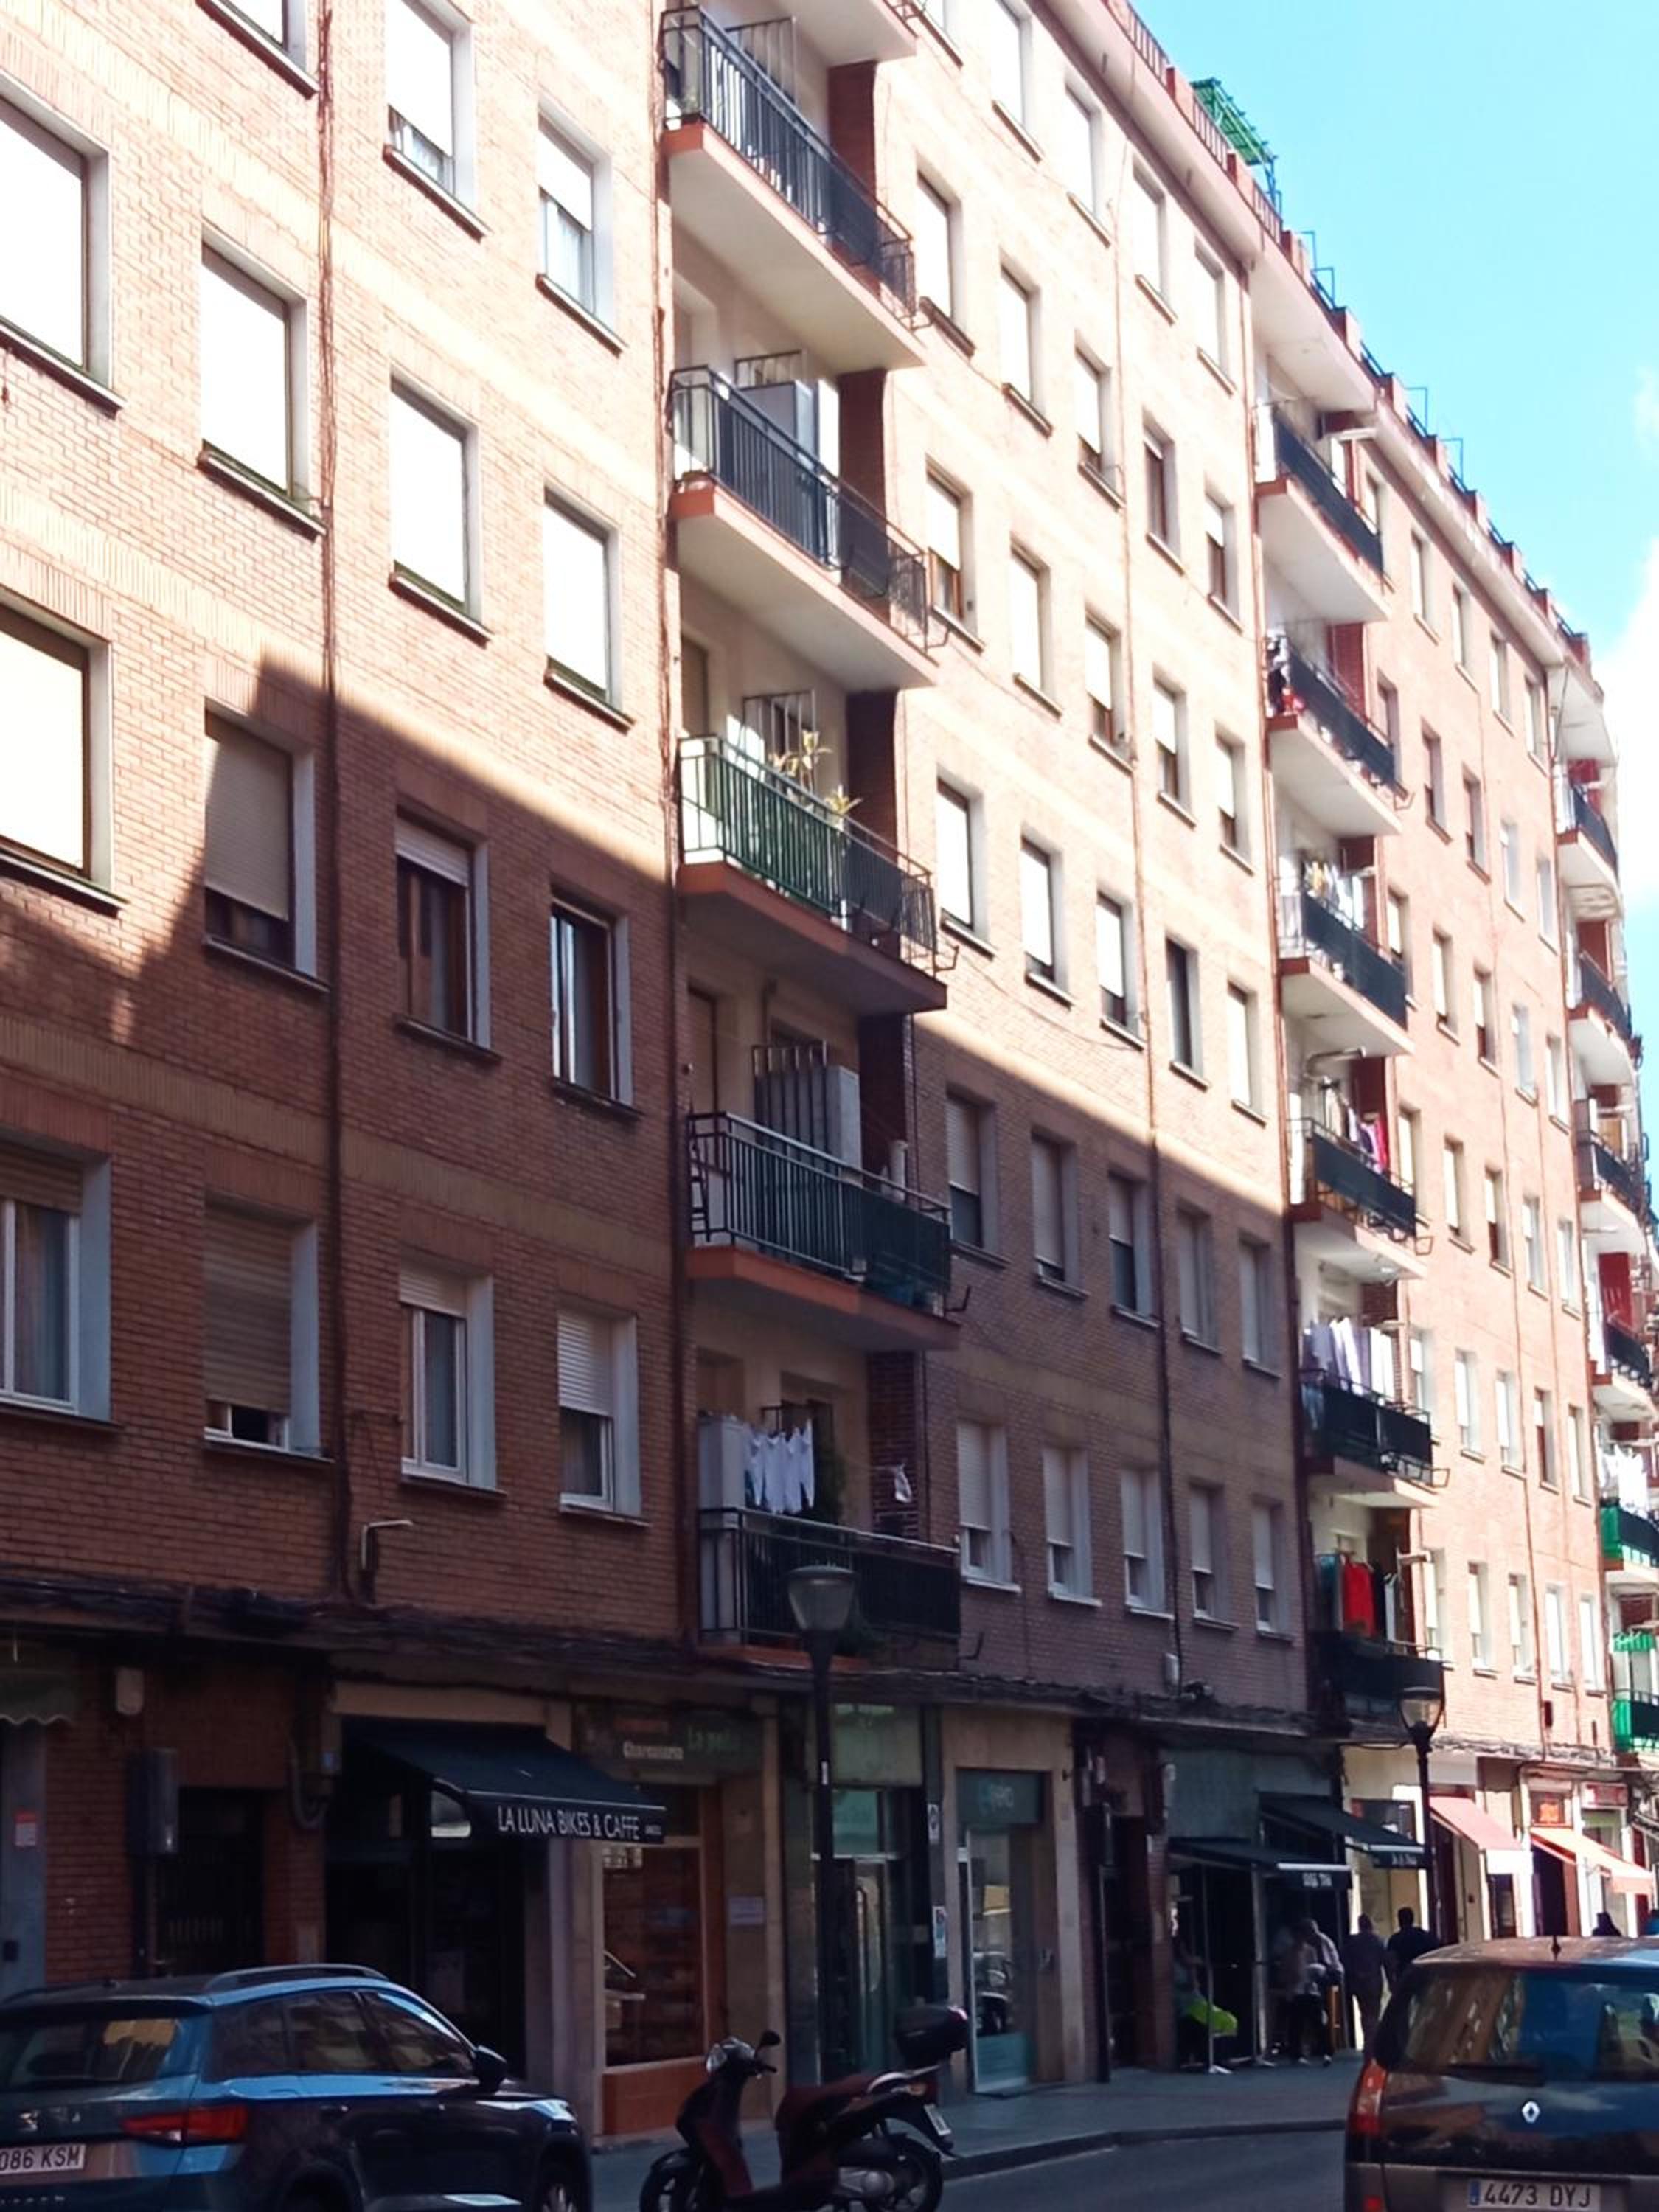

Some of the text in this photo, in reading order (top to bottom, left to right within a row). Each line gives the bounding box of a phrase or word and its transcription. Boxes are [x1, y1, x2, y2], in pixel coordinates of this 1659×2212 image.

[498, 1806, 515, 1832] LA
[518, 1807, 554, 1834] LUNA
[557, 1809, 591, 1836] BIKES
[593, 1814, 602, 1837] &
[41, 2146, 80, 2168] KSM
[1484, 2183, 1590, 2207] 4473 DYJ
